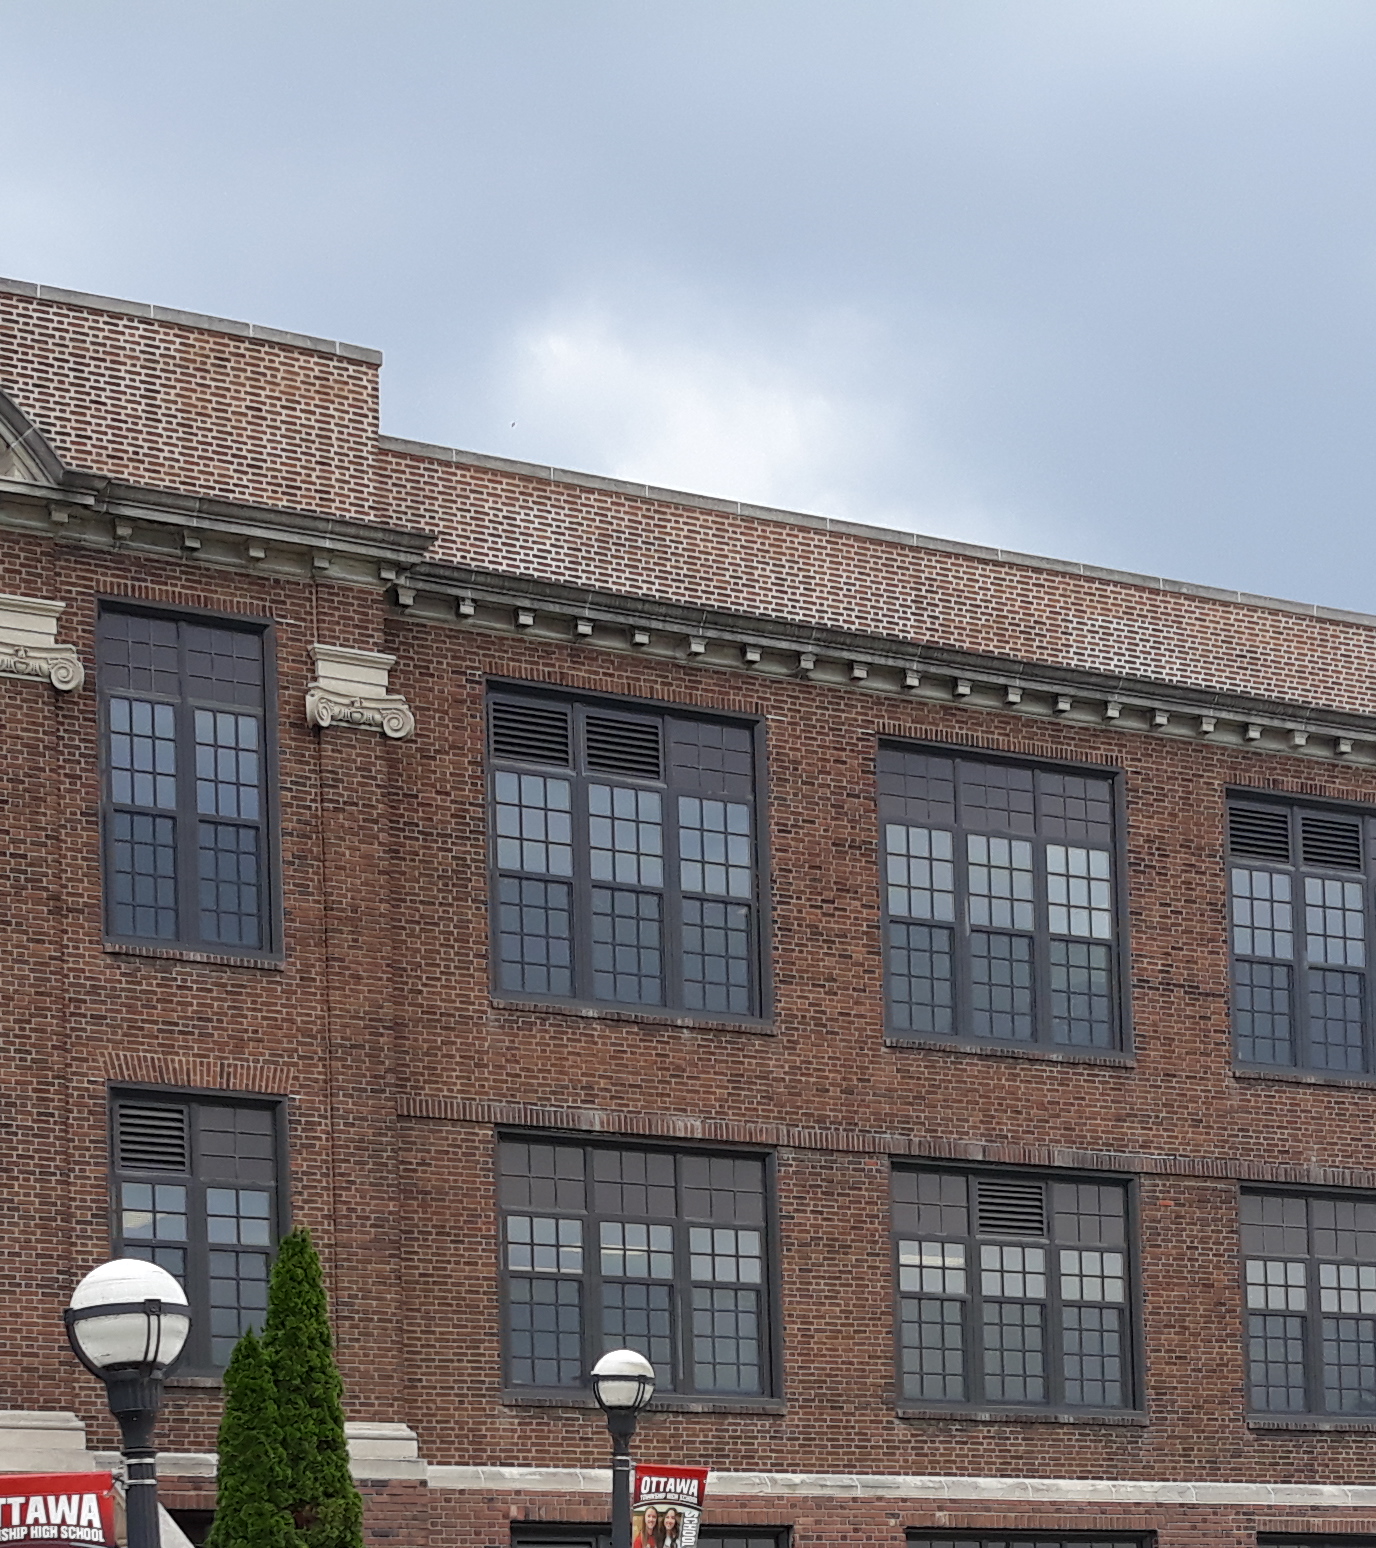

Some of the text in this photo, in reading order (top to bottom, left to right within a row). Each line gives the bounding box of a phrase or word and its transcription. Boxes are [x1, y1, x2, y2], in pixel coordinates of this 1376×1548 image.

[640, 1476, 699, 1498] OTTAWA
[30, 1525, 58, 1539] HIGH
[60, 1526, 106, 1543] SCHOOL
[682, 1510, 699, 1546] SCHOOL
